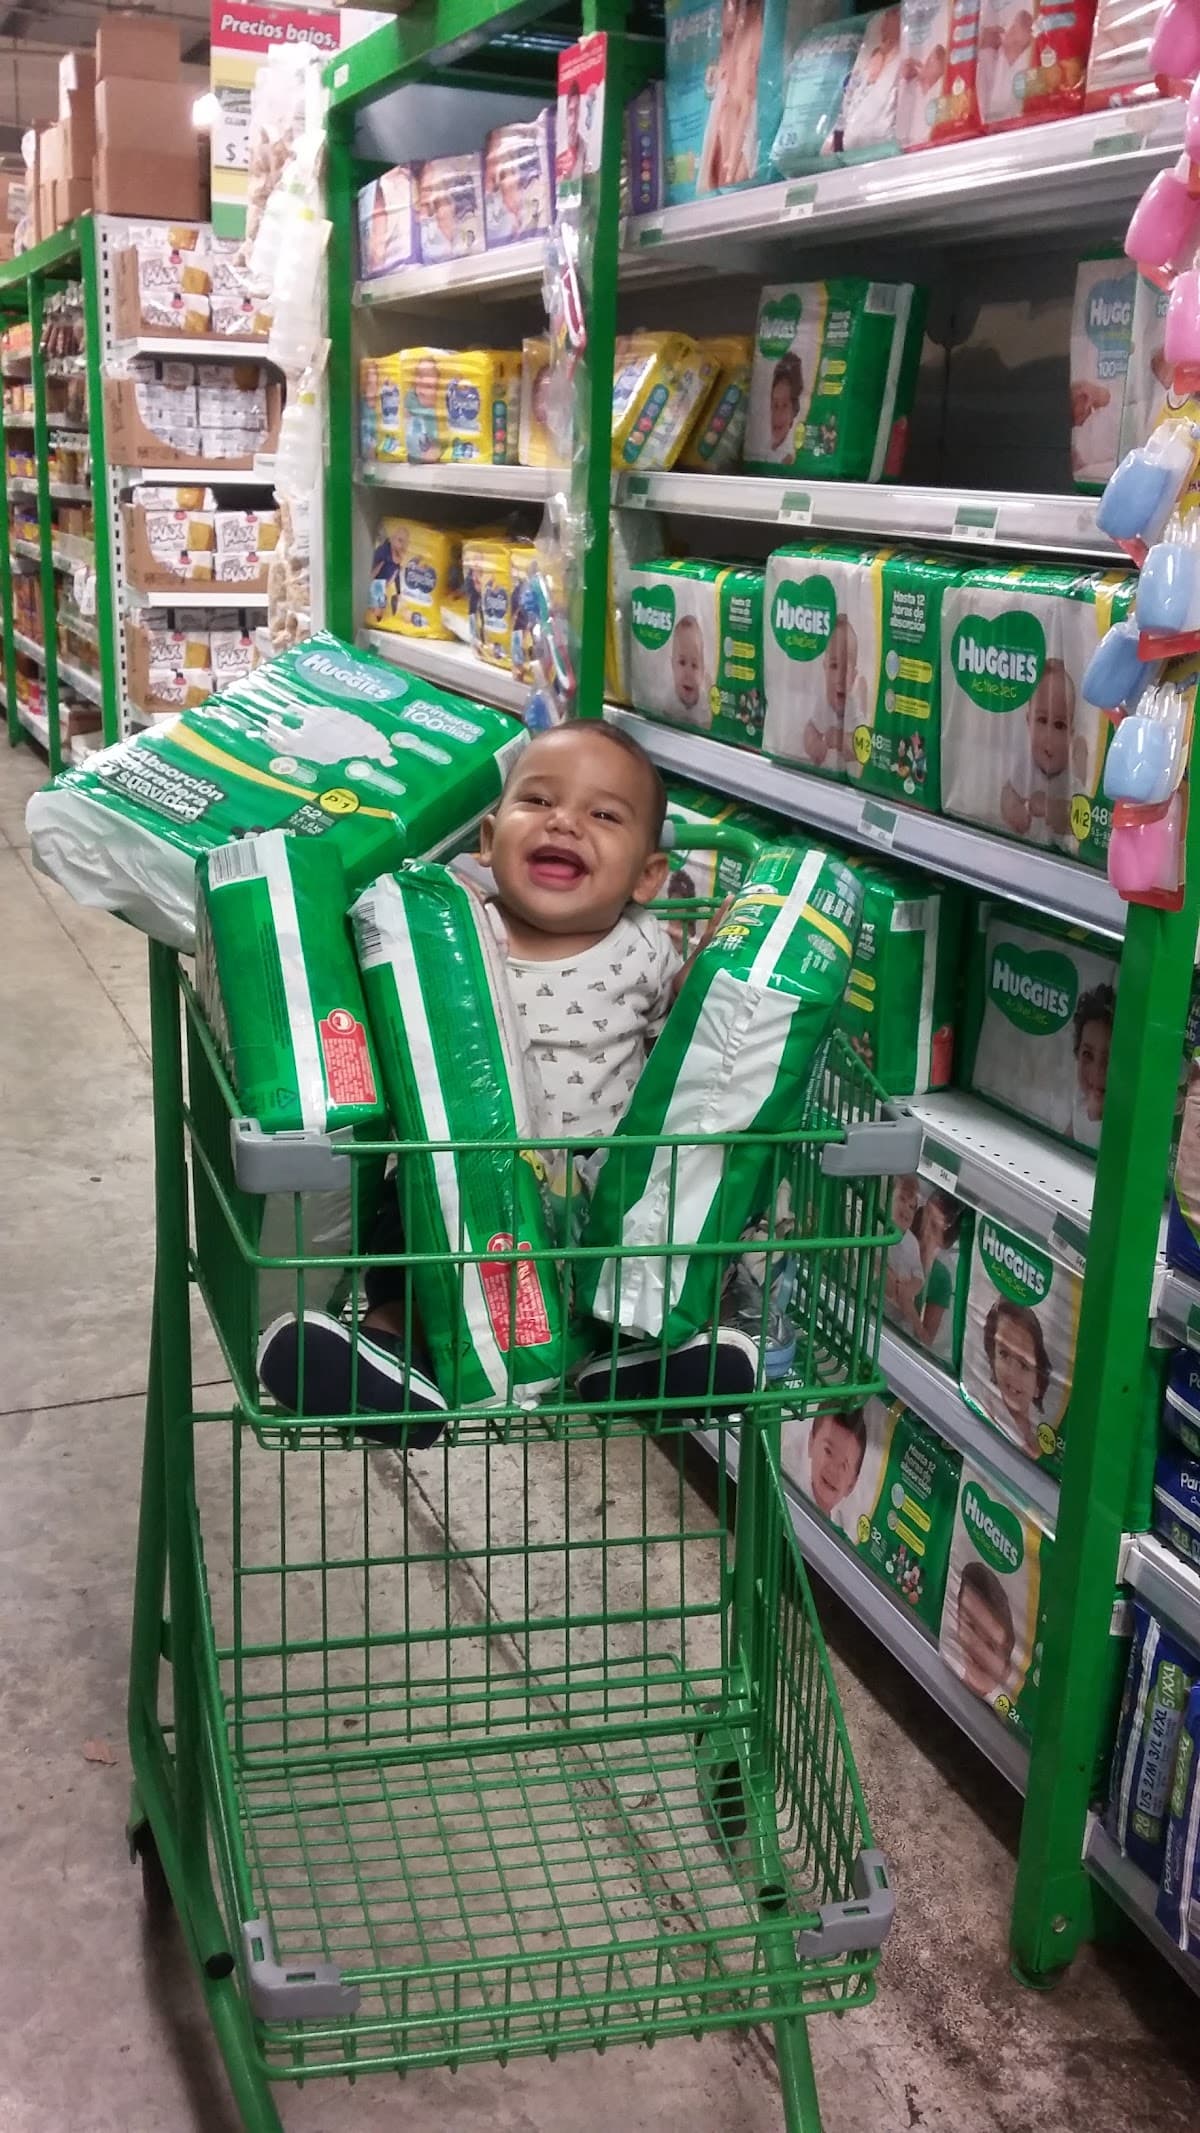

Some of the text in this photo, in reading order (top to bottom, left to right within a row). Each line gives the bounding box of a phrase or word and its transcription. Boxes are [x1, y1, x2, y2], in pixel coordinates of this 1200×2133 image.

[220, 14, 338, 48] Precios bajos,
[893, 590, 925, 606] Hasta 12
[775, 598, 831, 637] HUGGIES
[302, 653, 393, 699] HUGGIES
[958, 635, 1038, 684] HUGGIES
[299, 805, 323, 819] 52
[1091, 805, 1108, 826] 48
[992, 958, 1069, 1018] HUGGIES
[982, 1223, 1045, 1296] HUGGIES
[965, 1490, 1019, 1566] HUGGIES
[1162, 1663, 1176, 1708] 5/XXL
[1008, 1708, 1020, 1724] 24
[1153, 1709, 1168, 1738] 4/XL
[1149, 1740, 1162, 1760] 3/L
[1135, 1814, 1150, 1838] 28
